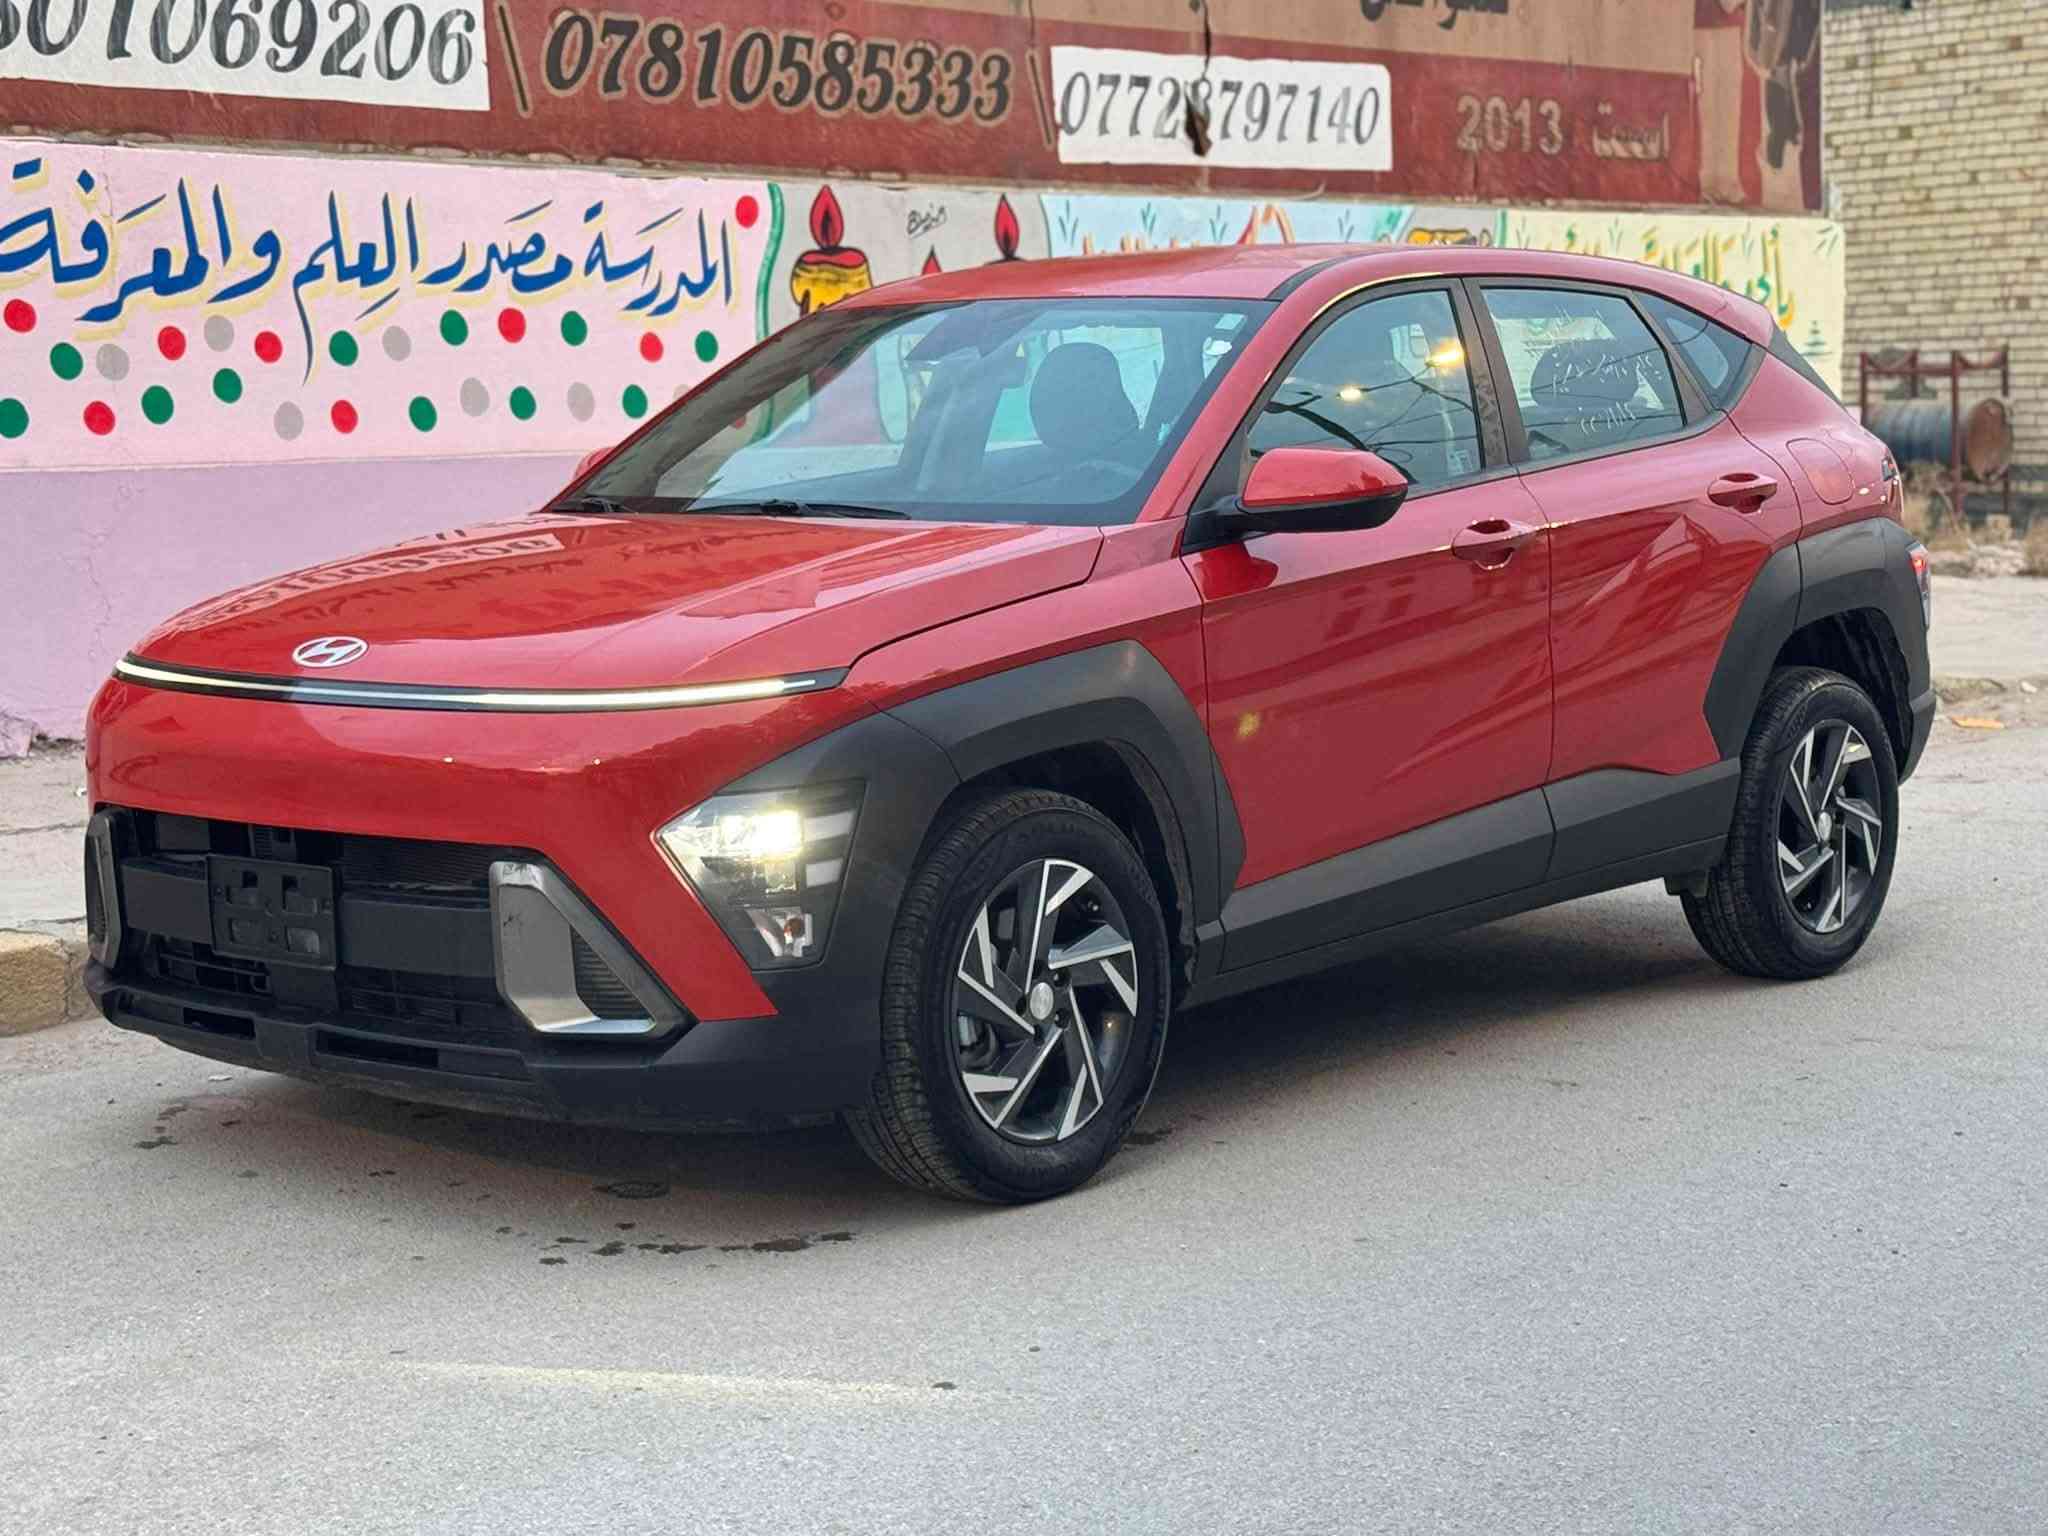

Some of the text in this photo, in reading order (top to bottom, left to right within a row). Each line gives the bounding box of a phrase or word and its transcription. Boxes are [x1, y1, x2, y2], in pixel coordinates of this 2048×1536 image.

[0, 0, 475, 84] 01069206
[544, 13, 1012, 123] 07810585333
[1456, 95, 1564, 155] 2013
[292, 190, 419, 386] العلم
[417, 199, 574, 294] مصدر
[583, 200, 732, 317] المدرسة
